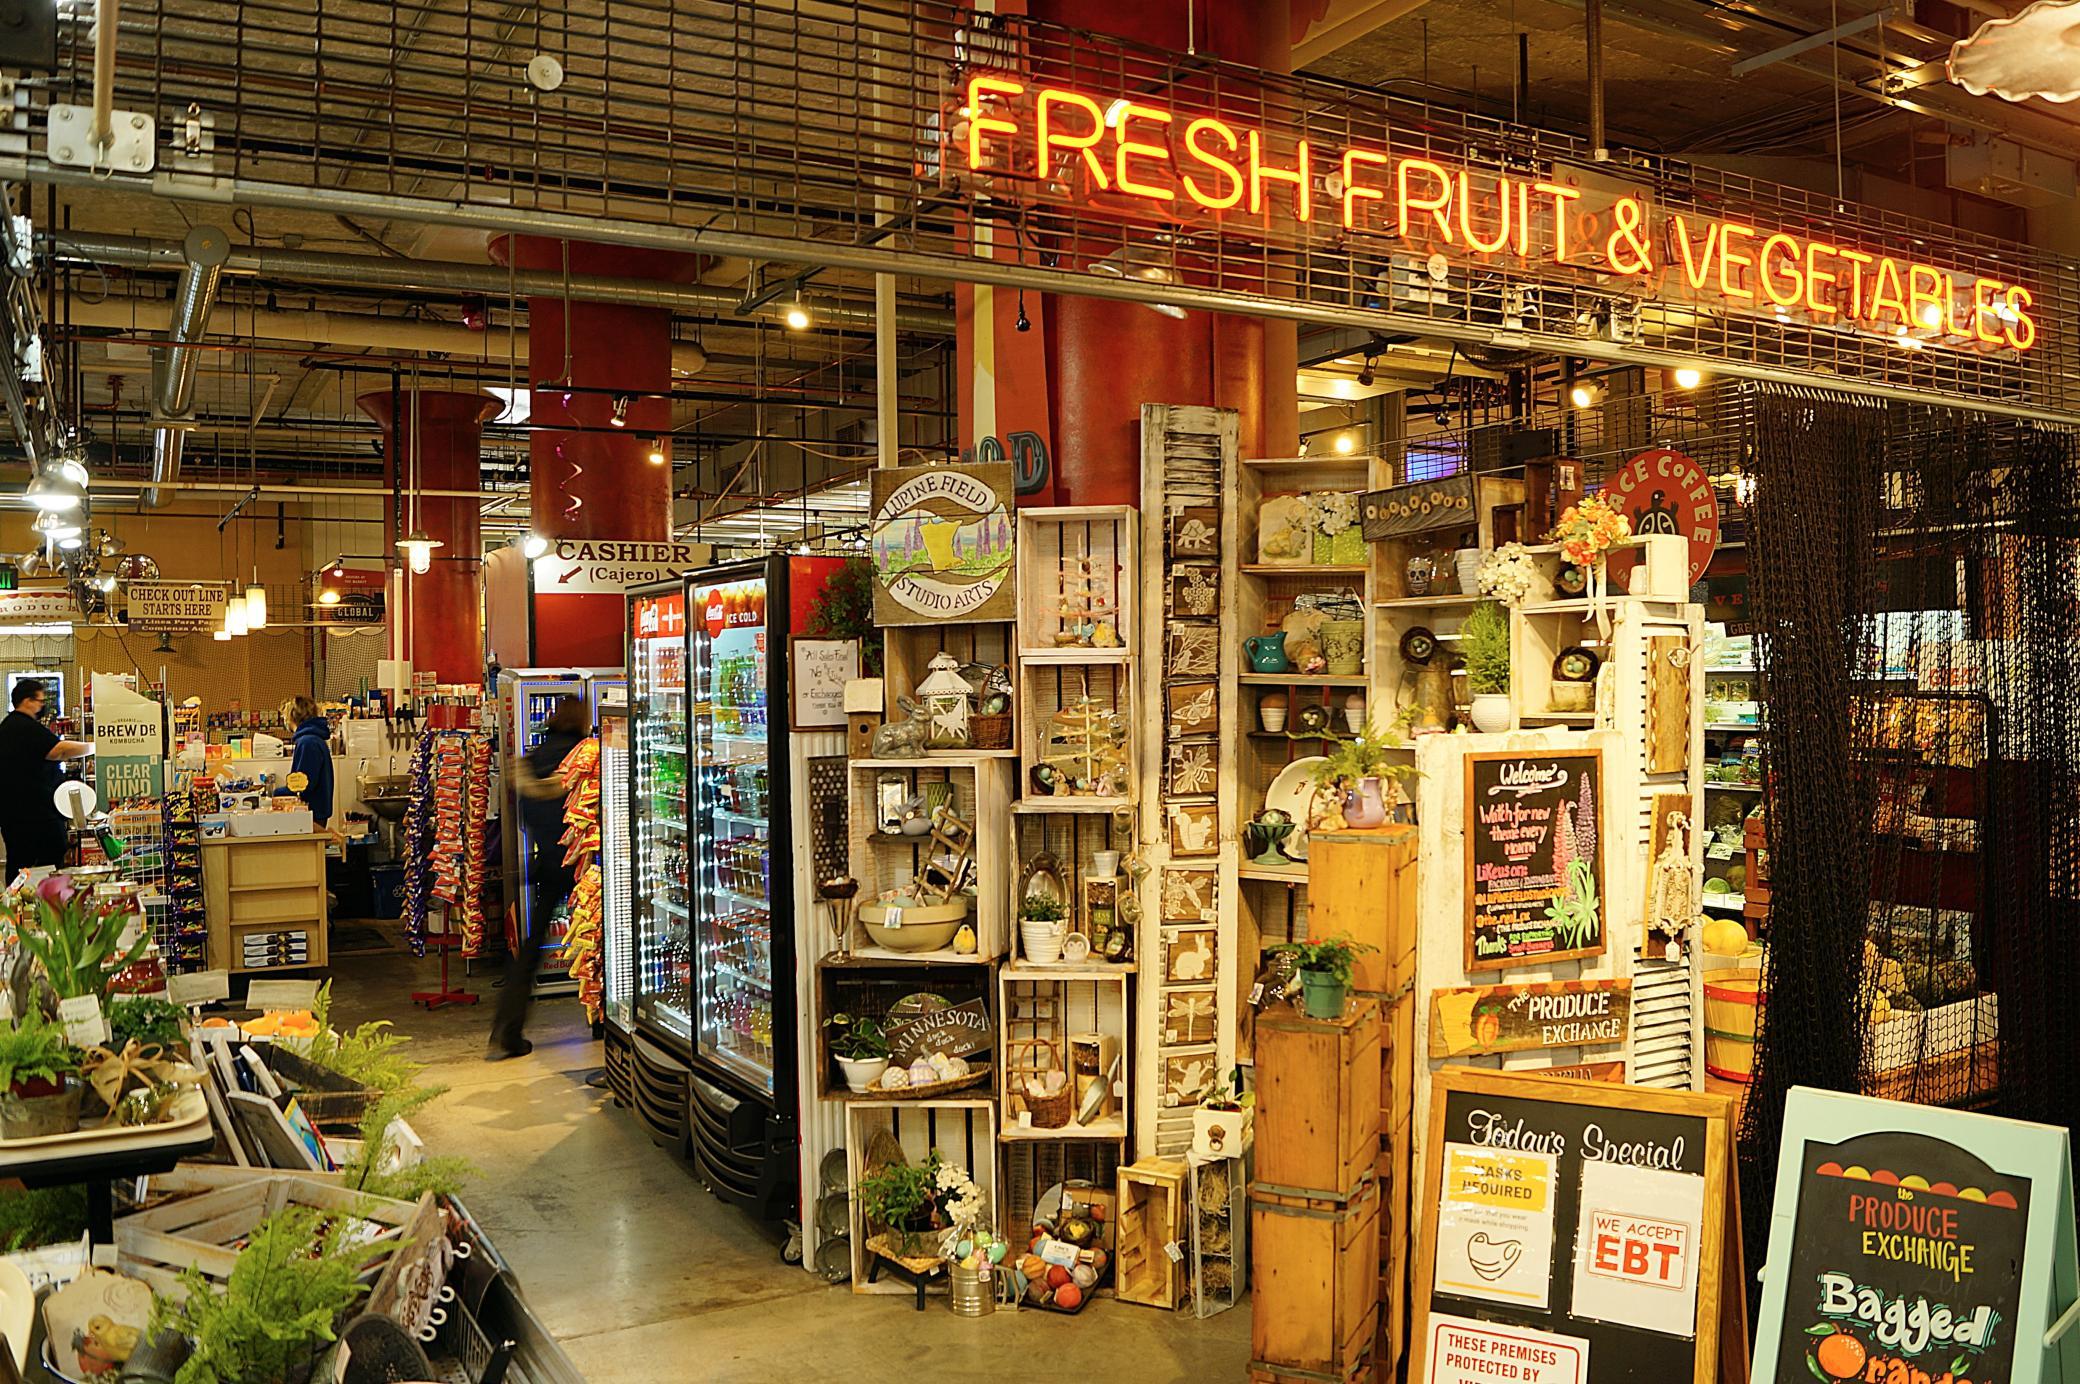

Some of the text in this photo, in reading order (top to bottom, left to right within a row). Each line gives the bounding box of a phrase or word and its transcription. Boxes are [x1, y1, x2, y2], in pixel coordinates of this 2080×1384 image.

[968, 77, 2037, 350] FRESH FRUIT & VEGETABLES
[883, 475, 988, 518] LUPINE FIELD
[555, 542, 693, 563] CASHIER
[589, 566, 661, 583] (Cajero)
[130, 588, 224, 602] CHECK OUT LINE
[896, 577, 994, 610] STUDIO ARTS
[0, 604, 79, 613] RODUCE
[143, 603, 212, 616] STARTS HERE
[337, 607, 374, 617] GLOBAL
[727, 612, 738, 624] ICE
[739, 611, 758, 623] COLD
[97, 724, 156, 737] BREW DR
[109, 737, 145, 745] KOMBUCHA
[106, 763, 151, 779] CLEAR
[1500, 760, 1558, 785] Welcome
[106, 779, 152, 799] MIND
[1479, 802, 1551, 829] Watch for new
[1520, 825, 1548, 844] every
[1504, 841, 1537, 855] MONTH
[1507, 988, 1530, 1013] THE
[1528, 992, 1611, 1020] PRODUCE
[893, 1010, 988, 1058] MINNESOTA
[926, 1030, 947, 1043] duck
[935, 1034, 956, 1047] duck
[1542, 1018, 1621, 1045] EXCHANGE
[1467, 1109, 1685, 1171] Today's Special
[1897, 1187, 1914, 1201] the
[1849, 1194, 1959, 1239] PRODUCE
[1596, 1217, 1684, 1241] WE ACCEPT
[1595, 1233, 1680, 1280] EBT
[1862, 1231, 1975, 1283] EXCHANGE
[1823, 1273, 1992, 1353] Bagged
[1448, 1333, 1558, 1365] THESE PREMISES
[1446, 1353, 1540, 1382] PROTECTED BY
